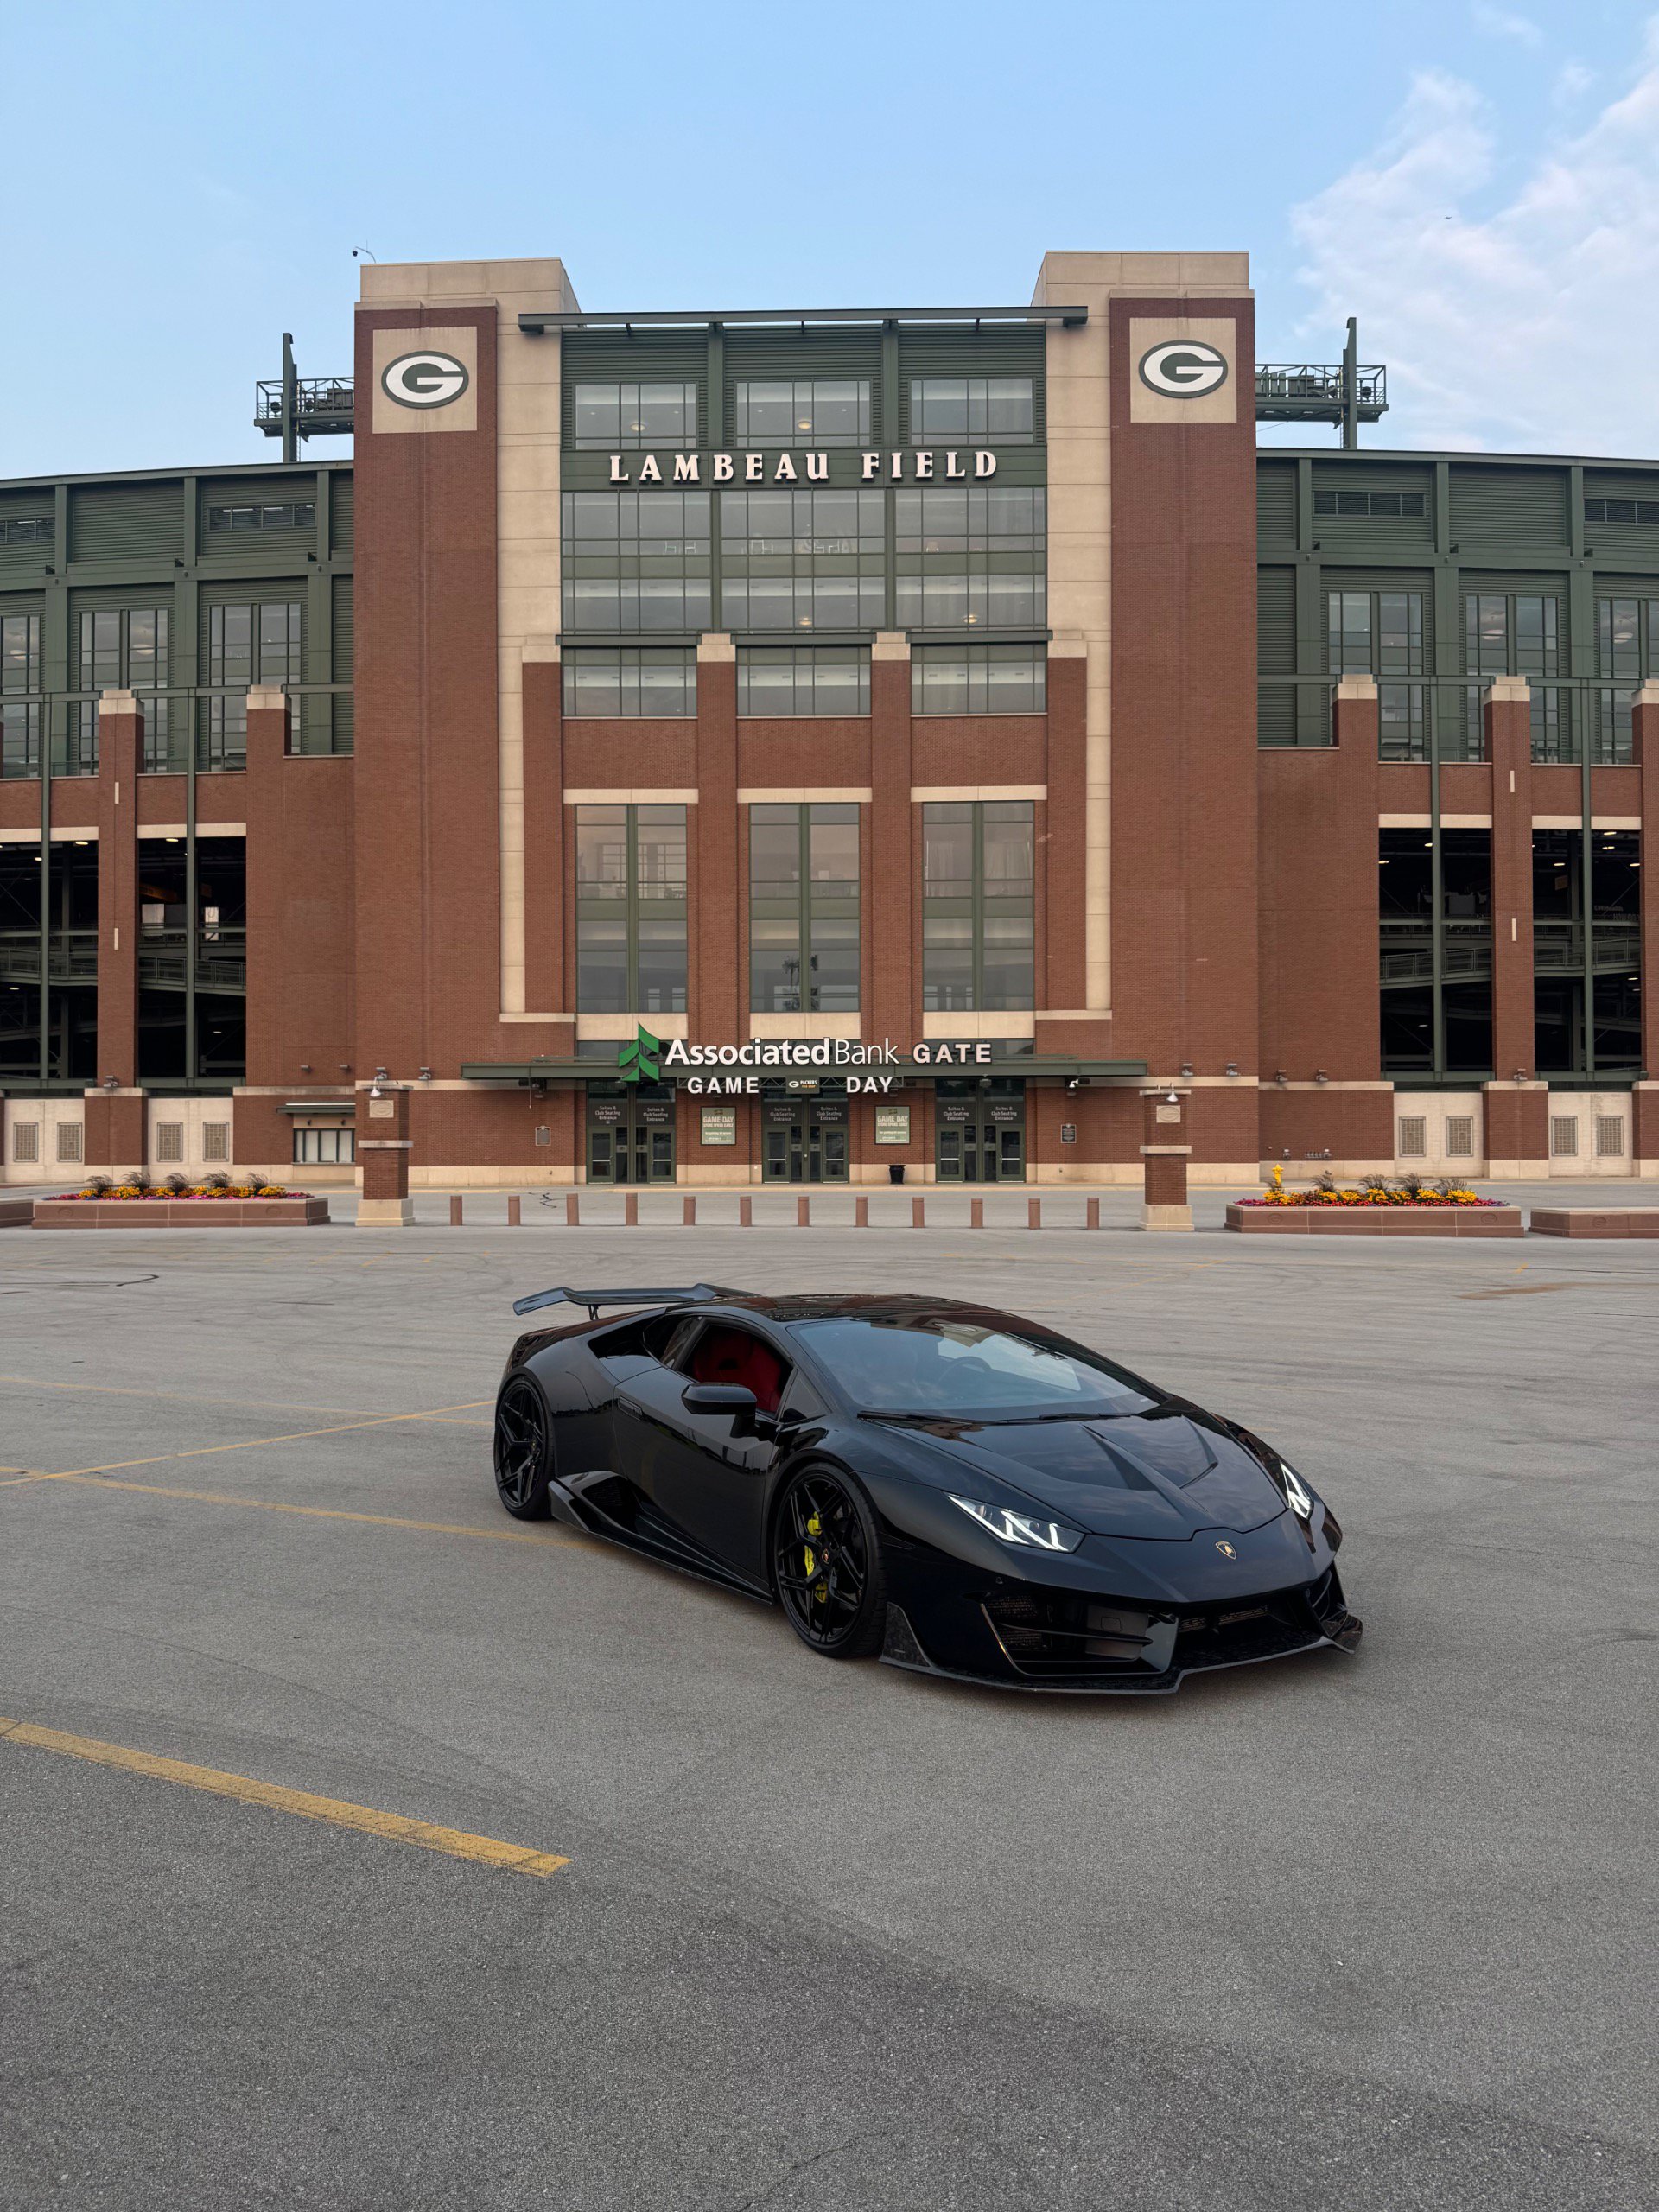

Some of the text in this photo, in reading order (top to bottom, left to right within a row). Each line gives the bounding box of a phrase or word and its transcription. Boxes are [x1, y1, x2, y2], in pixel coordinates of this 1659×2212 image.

[385, 354, 464, 404] G
[1144, 344, 1224, 393] G
[609, 451, 997, 481] LAMBEAU FIELD
[913, 1043, 991, 1063] GATE
[687, 1077, 893, 1094] GAME DAY
